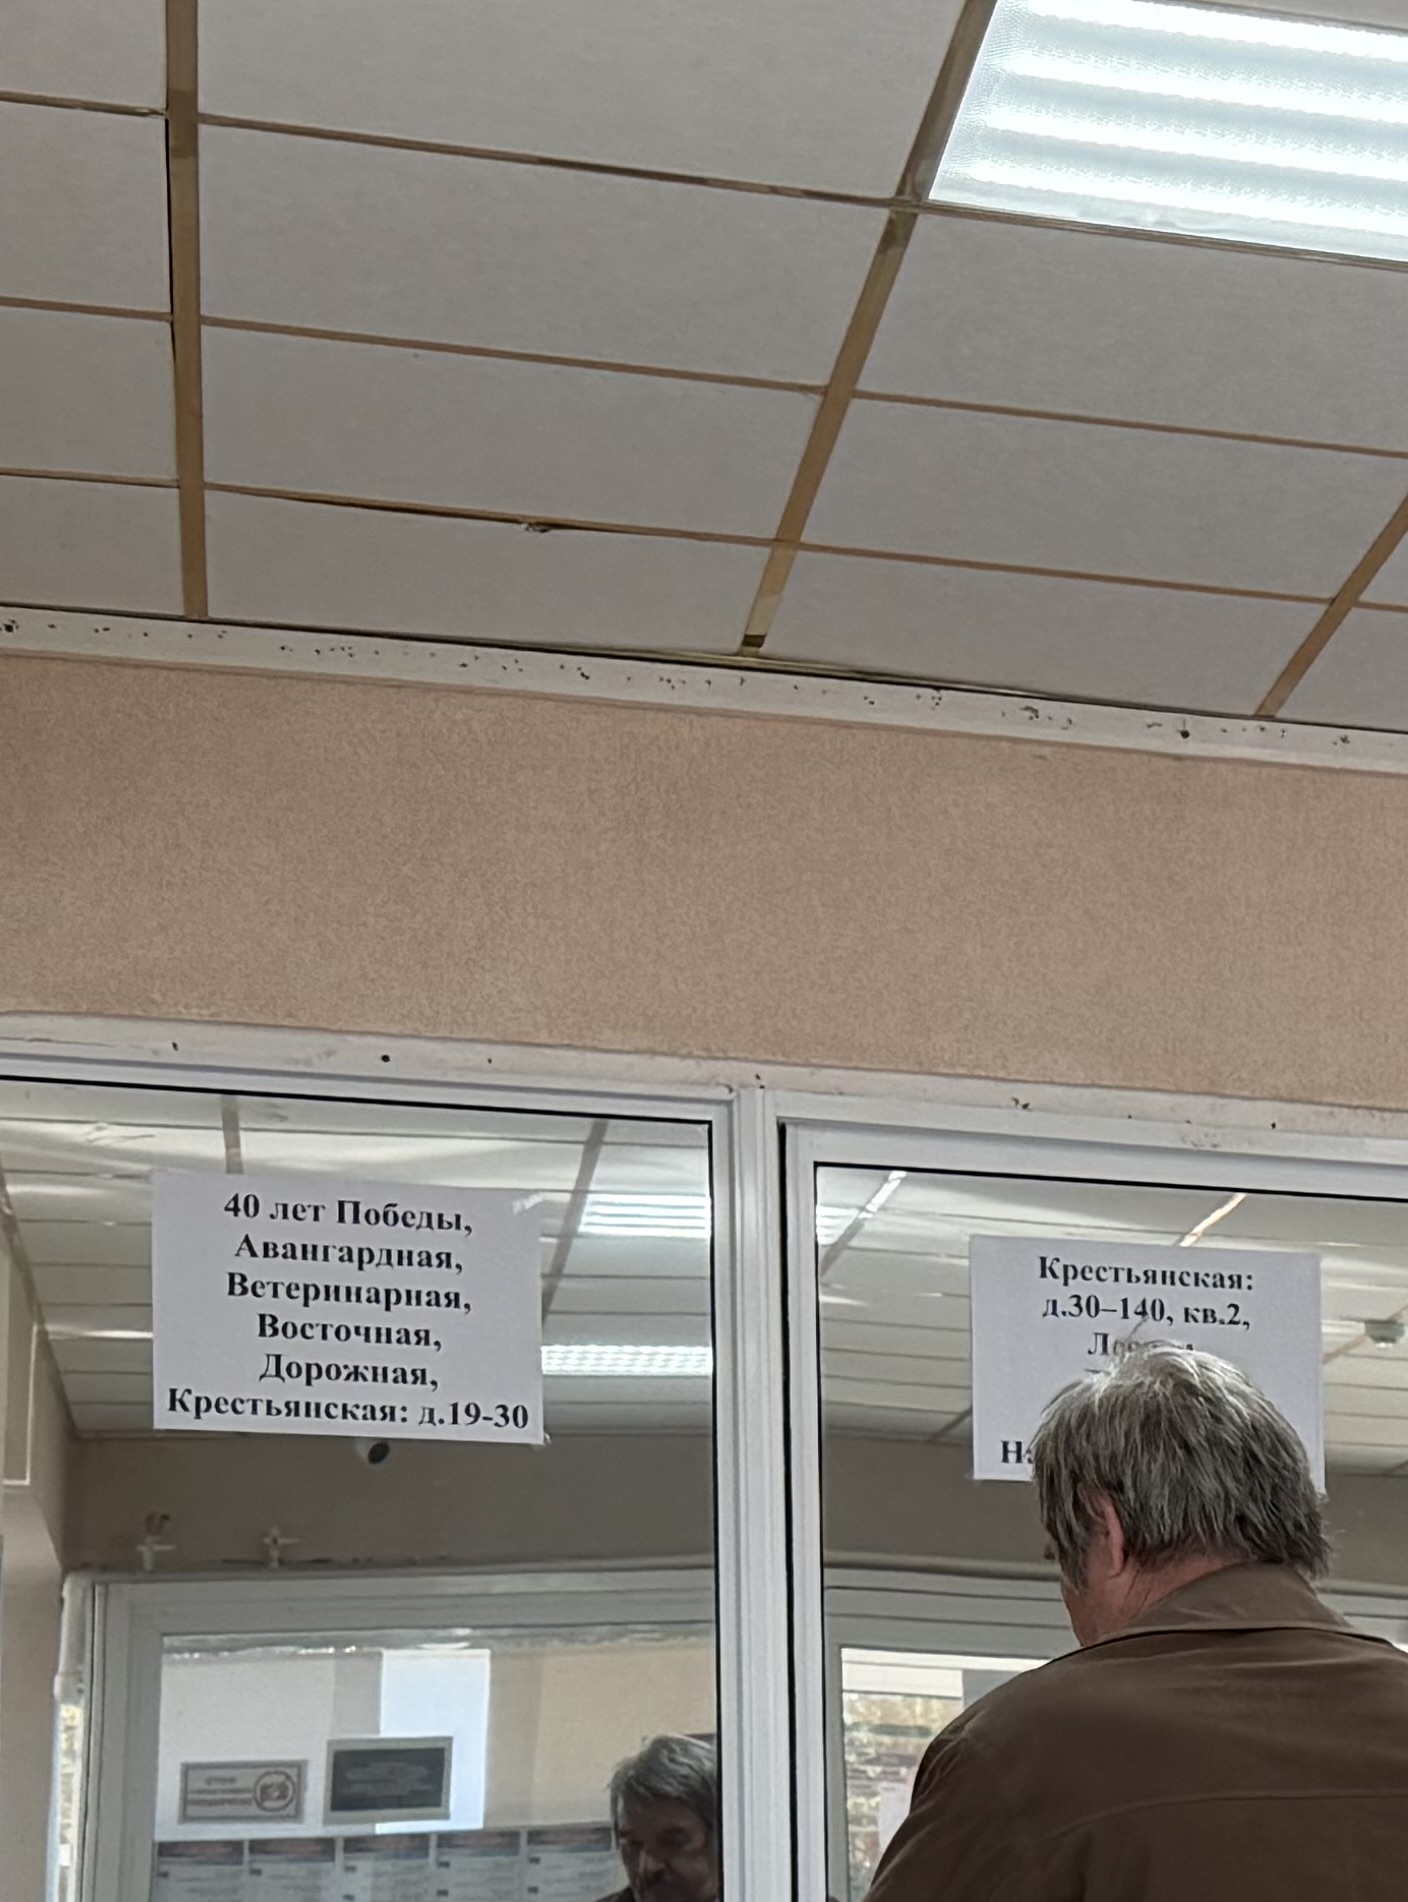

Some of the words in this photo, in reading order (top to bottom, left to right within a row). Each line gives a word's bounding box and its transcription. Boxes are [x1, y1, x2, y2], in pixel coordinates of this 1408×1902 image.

[223, 1193, 260, 1218] 40
[269, 1202, 326, 1222] лет
[337, 1199, 473, 1236] Победы,
[234, 1233, 463, 1274] Авангардная,
[1039, 1255, 1253, 1291] Крестьянская:
[227, 1271, 471, 1314] Ветеринарная,
[258, 1313, 442, 1352] Восточная,
[1183, 1302, 1250, 1331] кв.2,
[258, 1353, 438, 1392] Дорожная,
[168, 1387, 408, 1423] Крестьянская:
[418, 1401, 529, 1429] д.19-30
